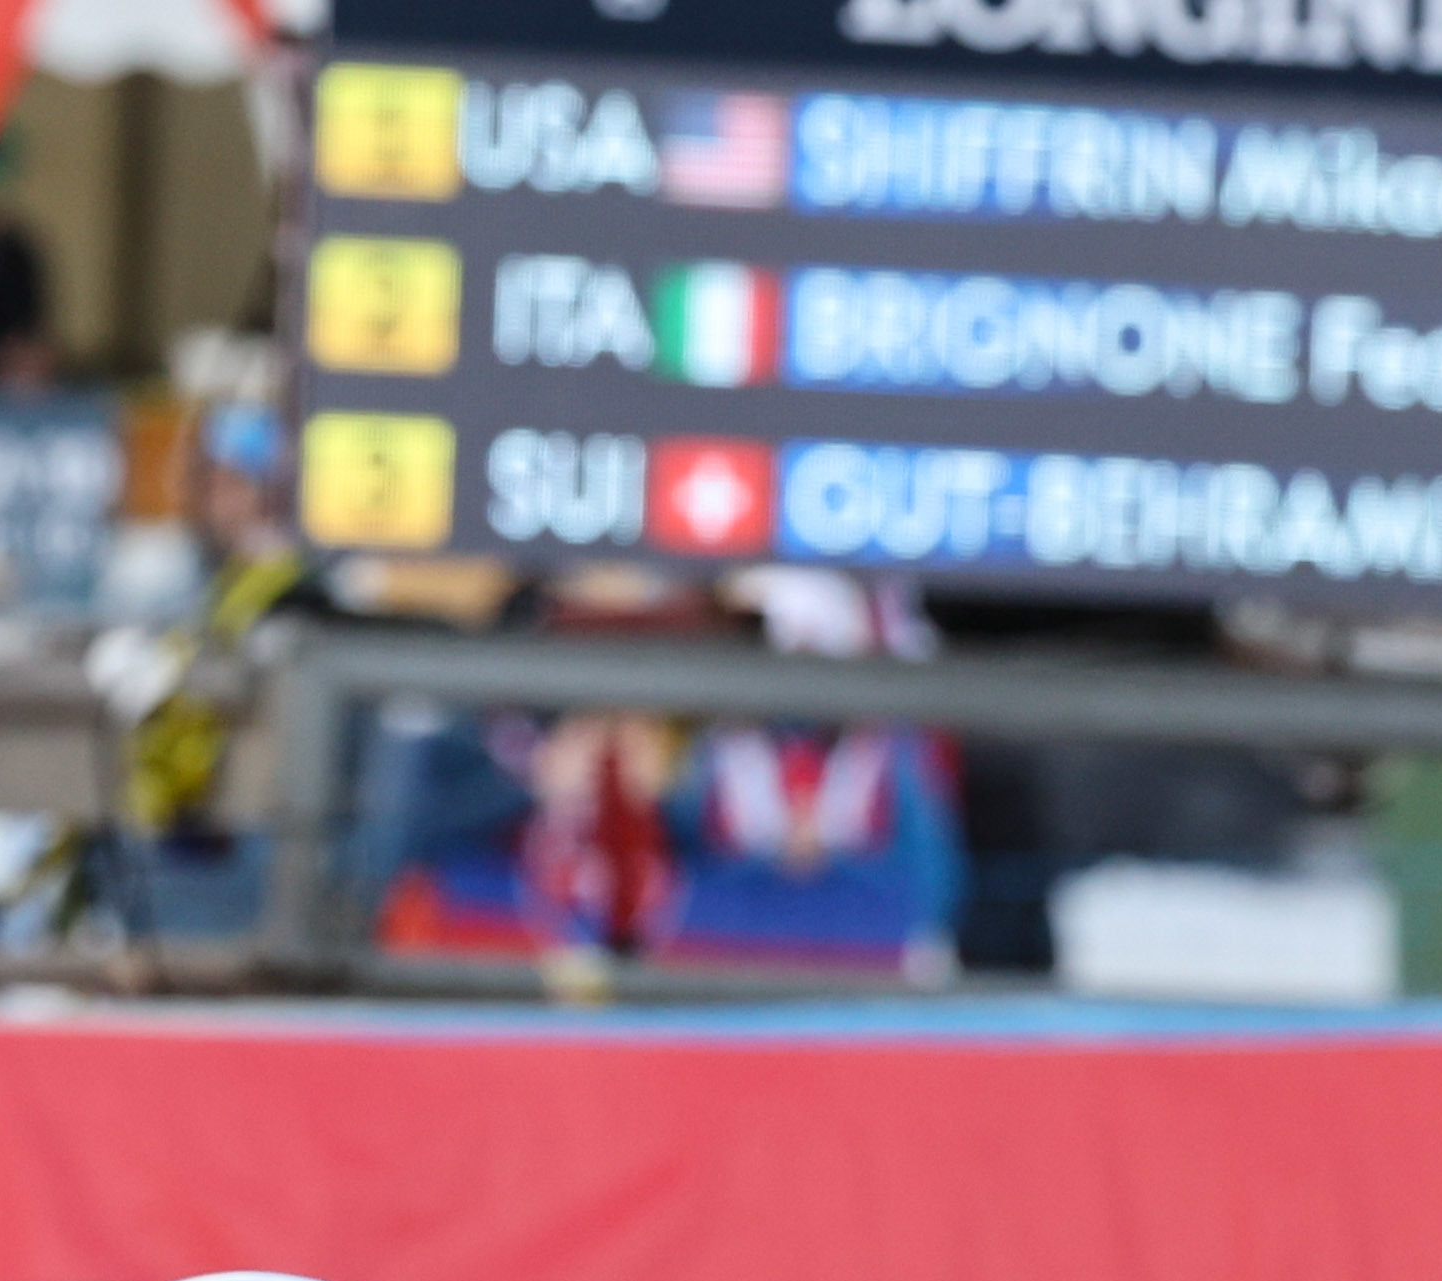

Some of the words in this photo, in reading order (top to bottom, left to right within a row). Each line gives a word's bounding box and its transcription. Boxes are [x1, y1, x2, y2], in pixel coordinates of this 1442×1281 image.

[459, 80, 659, 194] USA
[798, 95, 1217, 222] SHIFFRIN
[493, 255, 654, 368] ITA
[790, 268, 1302, 403] BRIGNONE
[486, 429, 647, 544] SUI
